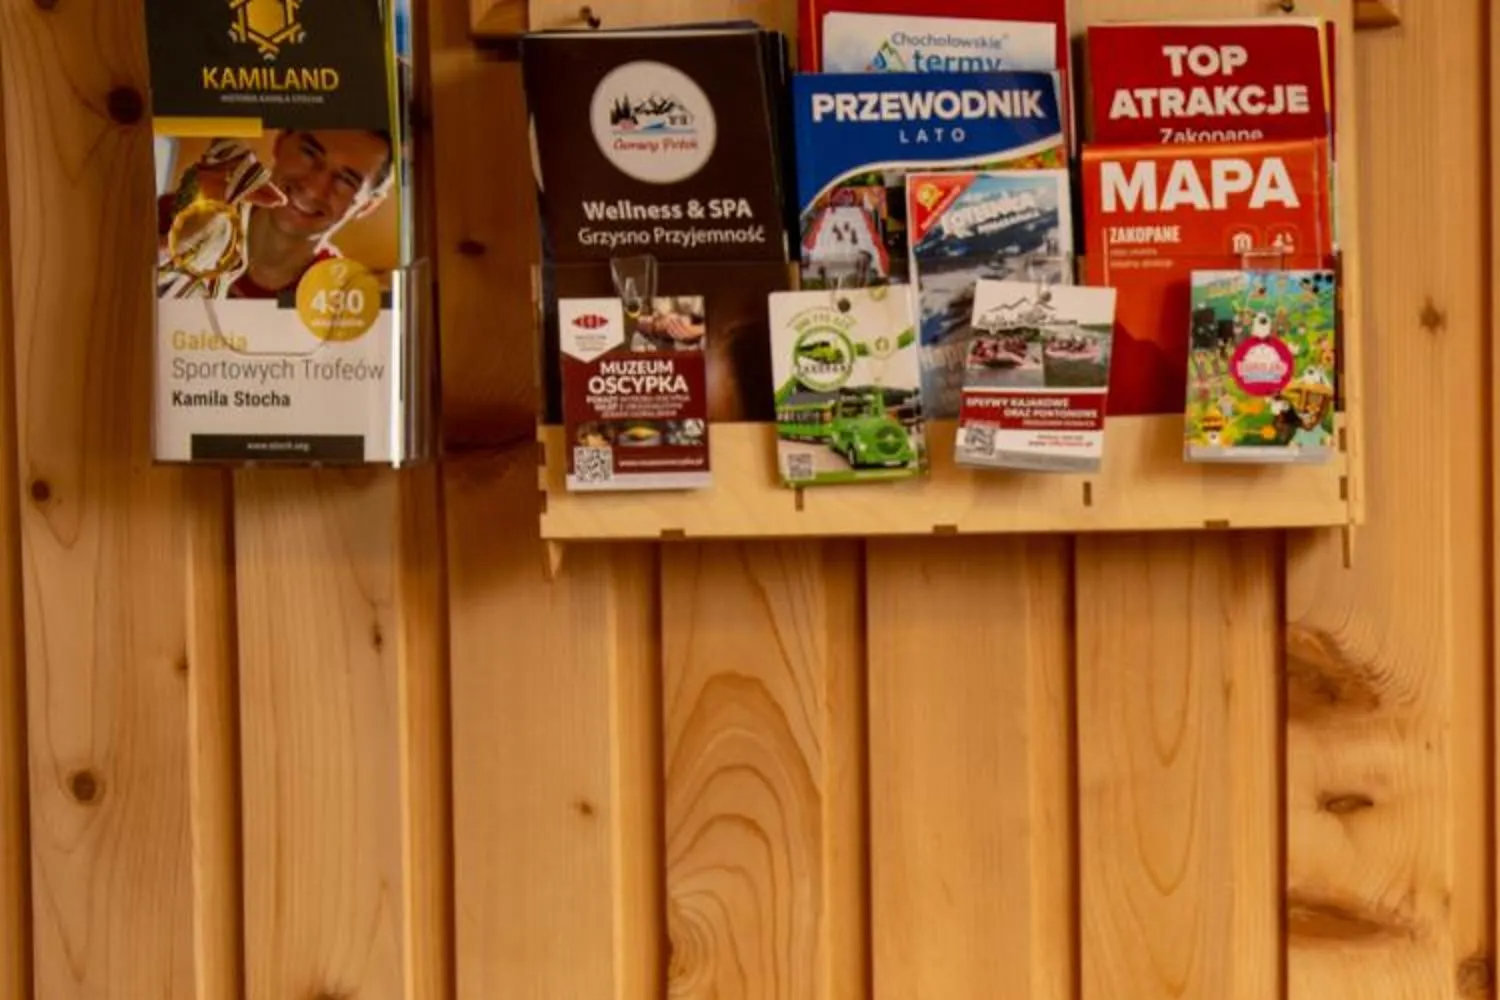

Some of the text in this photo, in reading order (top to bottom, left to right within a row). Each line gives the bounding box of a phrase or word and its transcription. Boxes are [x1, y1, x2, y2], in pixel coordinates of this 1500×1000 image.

[1162, 45, 1249, 77] TOP
[202, 66, 340, 91] KAMILAND
[810, 89, 1047, 122] PRZEWODNIK
[1109, 84, 1311, 120] ATRAKCJE
[899, 127, 966, 143] LATO
[1100, 156, 1301, 213] MAPA
[582, 198, 752, 220] Wellness & SPA
[653, 224, 766, 248] Przyjemność
[1109, 225, 1181, 244] ZAKOPANE
[310, 288, 365, 314] 430
[172, 329, 248, 350] Galeria
[172, 357, 385, 384] Sportowych Trofeów
[600, 360, 673, 376] MUZEUM
[588, 374, 689, 395] OSCYPKA
[172, 390, 291, 407] Kamila Stocha
